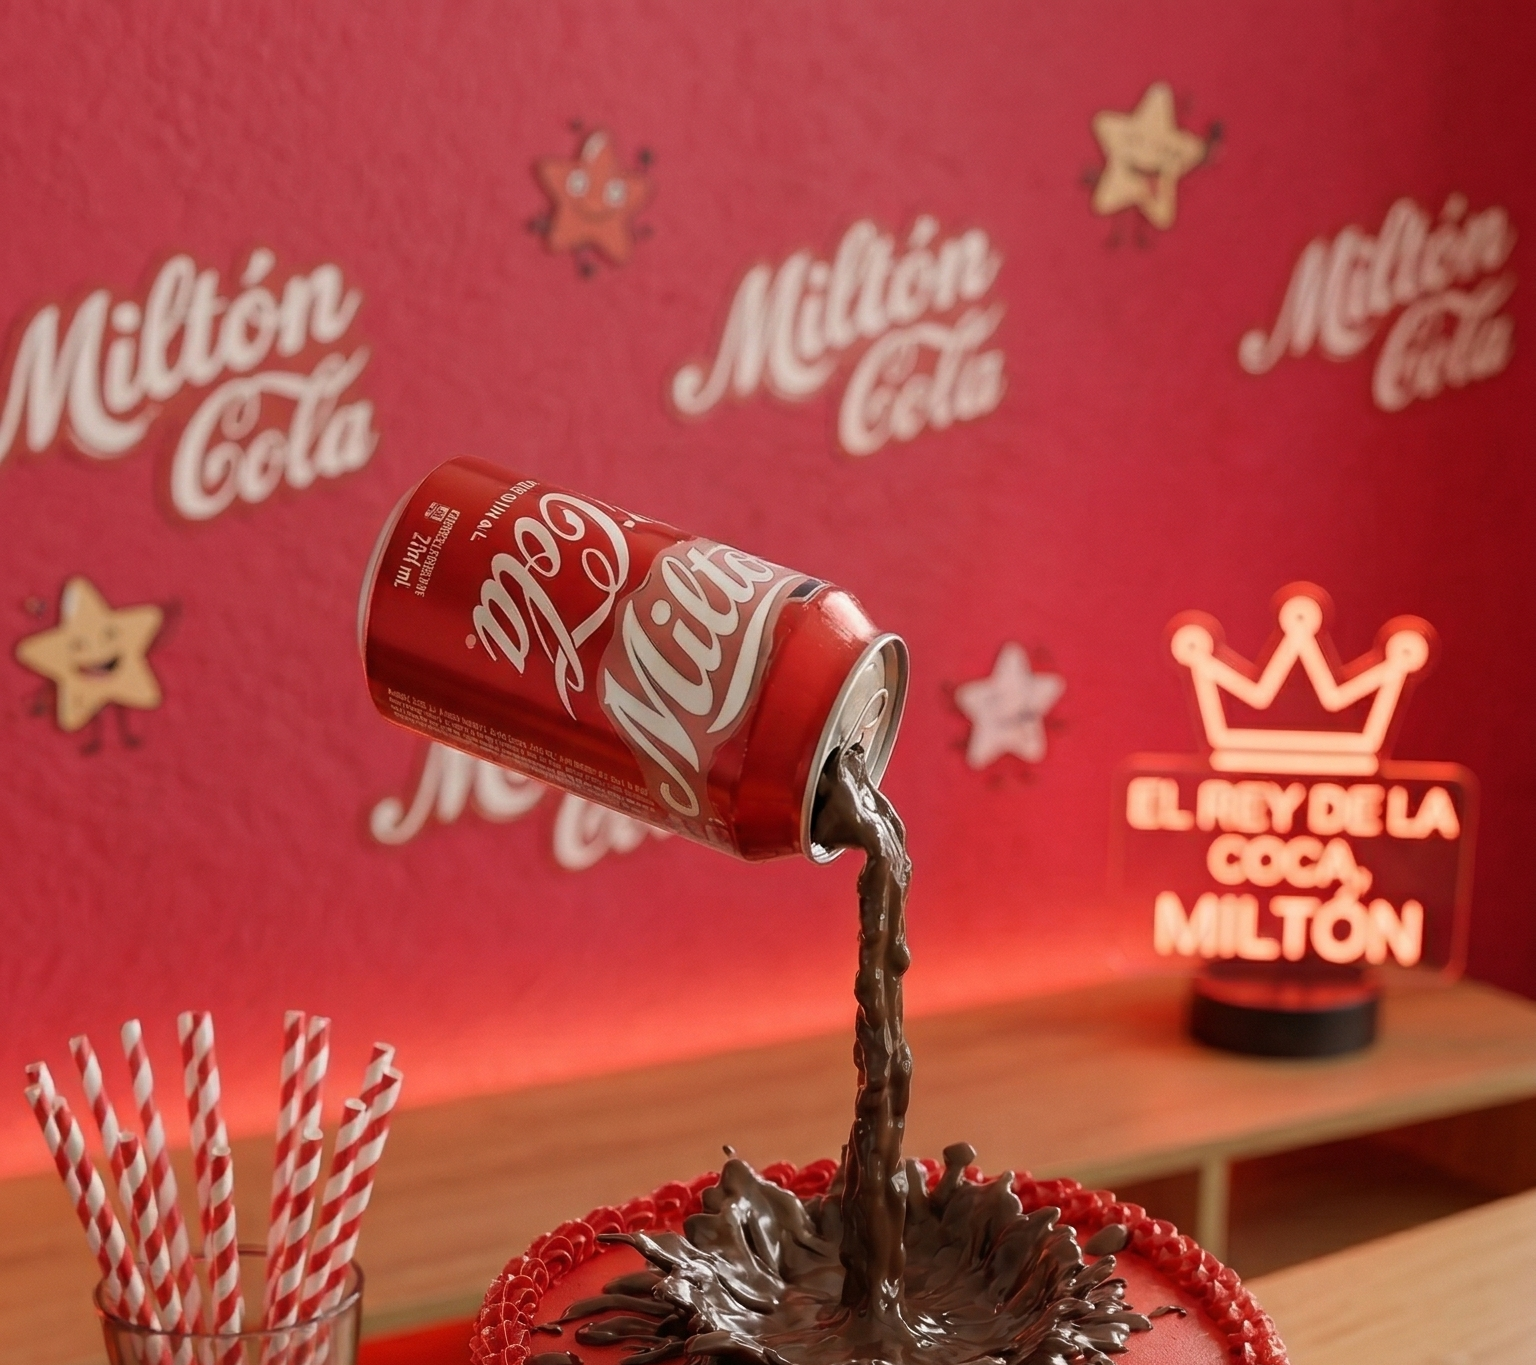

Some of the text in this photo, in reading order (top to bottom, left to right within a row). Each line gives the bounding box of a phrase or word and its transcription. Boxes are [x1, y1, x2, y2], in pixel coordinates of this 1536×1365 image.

[0, 248, 363, 463] Miltón
[671, 214, 1004, 417] Miltón
[1238, 192, 1515, 375] Miltón
[1371, 272, 1516, 412] Cola
[169, 347, 379, 521] Cola
[836, 298, 1007, 456] Cola
[472, 493, 628, 720] Cola
[1127, 777, 1460, 840] EL REY DE LA
[1154, 885, 1423, 966] MILTÓN
